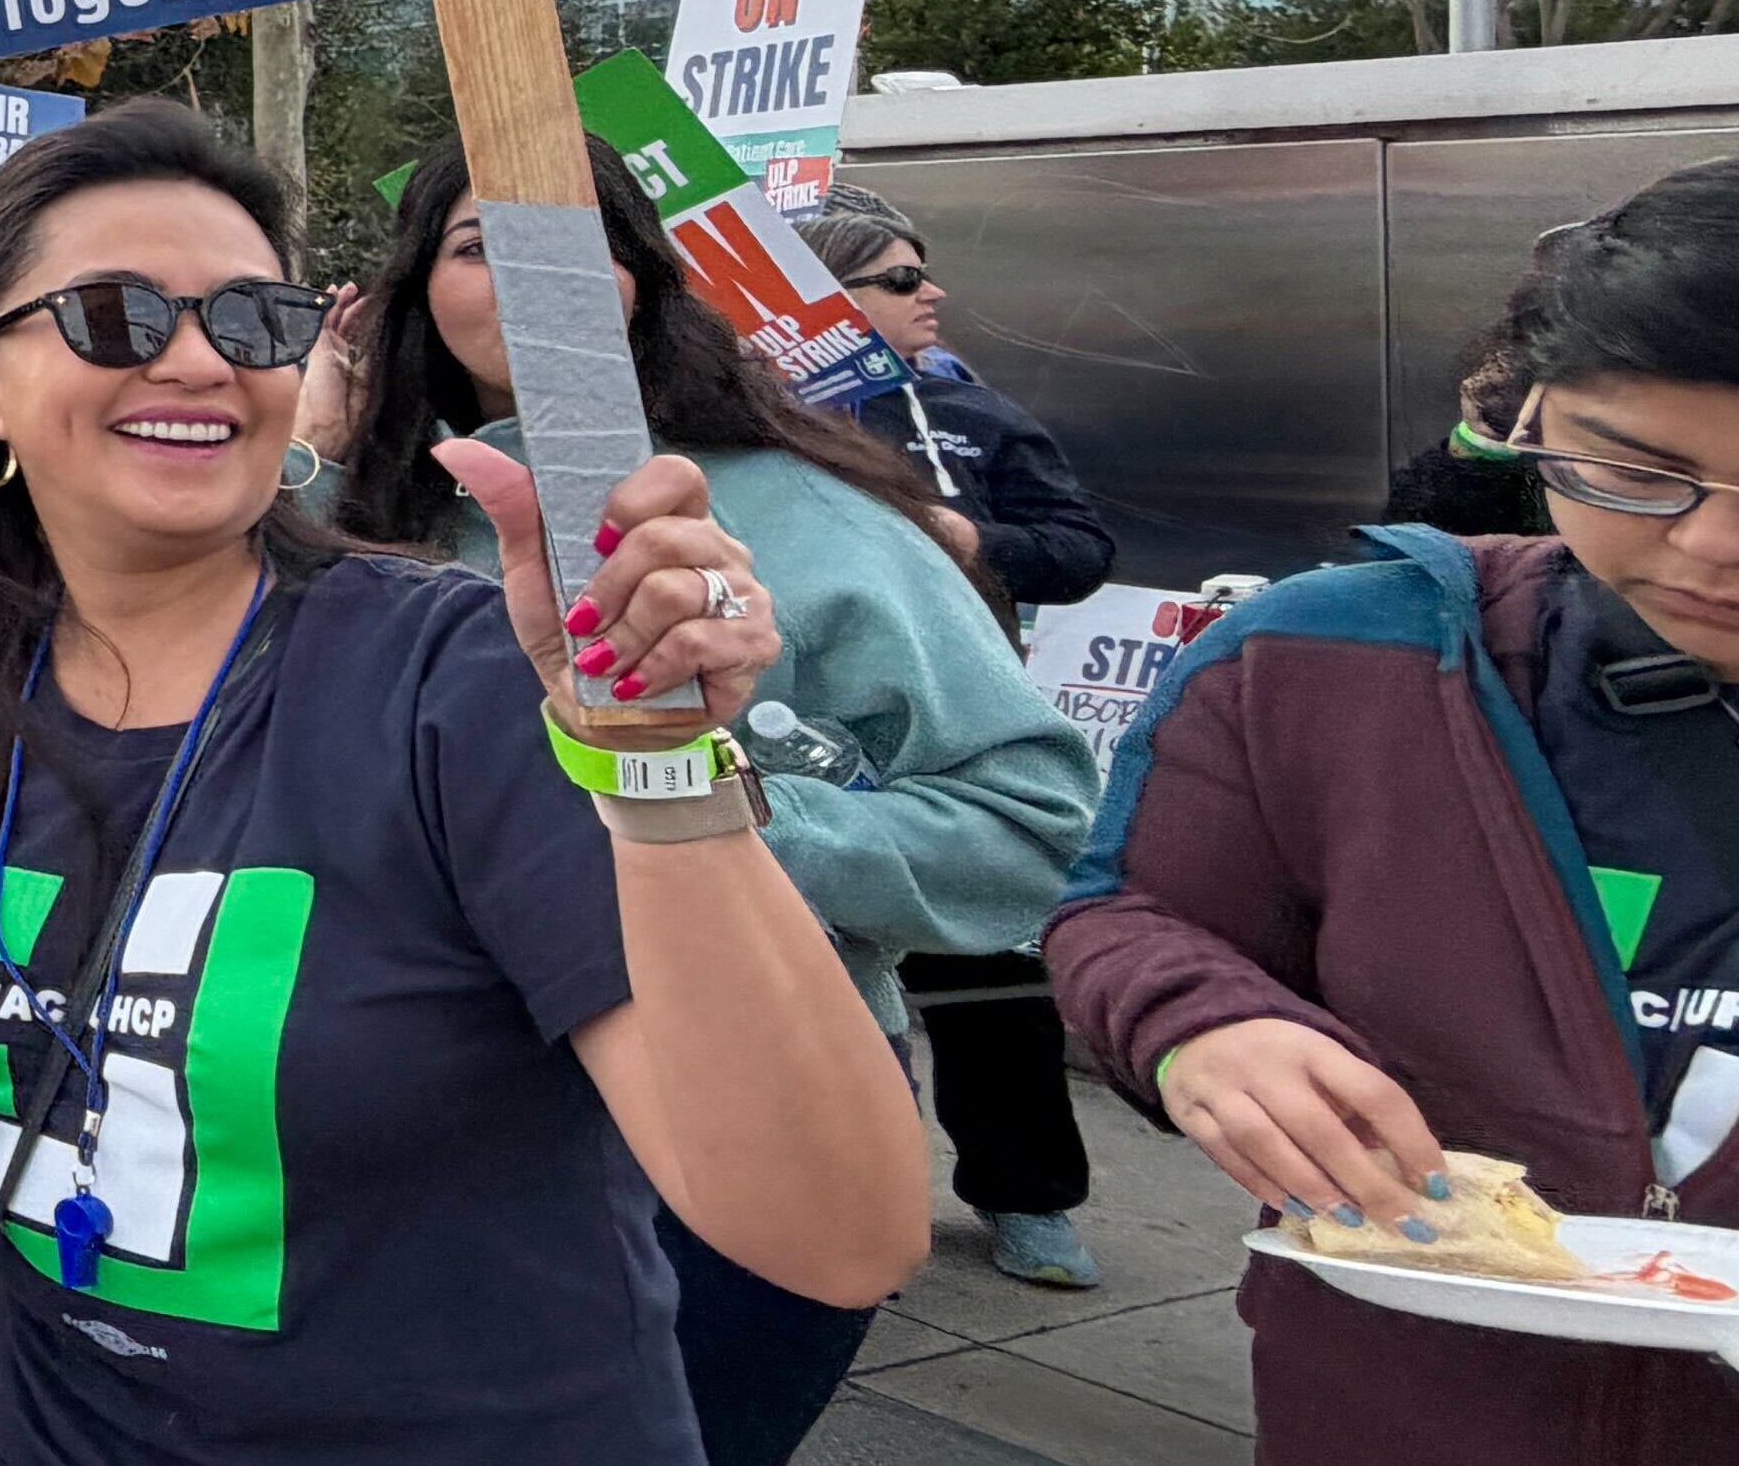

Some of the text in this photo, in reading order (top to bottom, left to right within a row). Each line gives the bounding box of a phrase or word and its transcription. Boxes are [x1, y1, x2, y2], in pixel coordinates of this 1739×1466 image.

[683, 34, 835, 118] STRIKE
[750, 314, 806, 357] ULP
[776, 319, 872, 382] STRIKE
